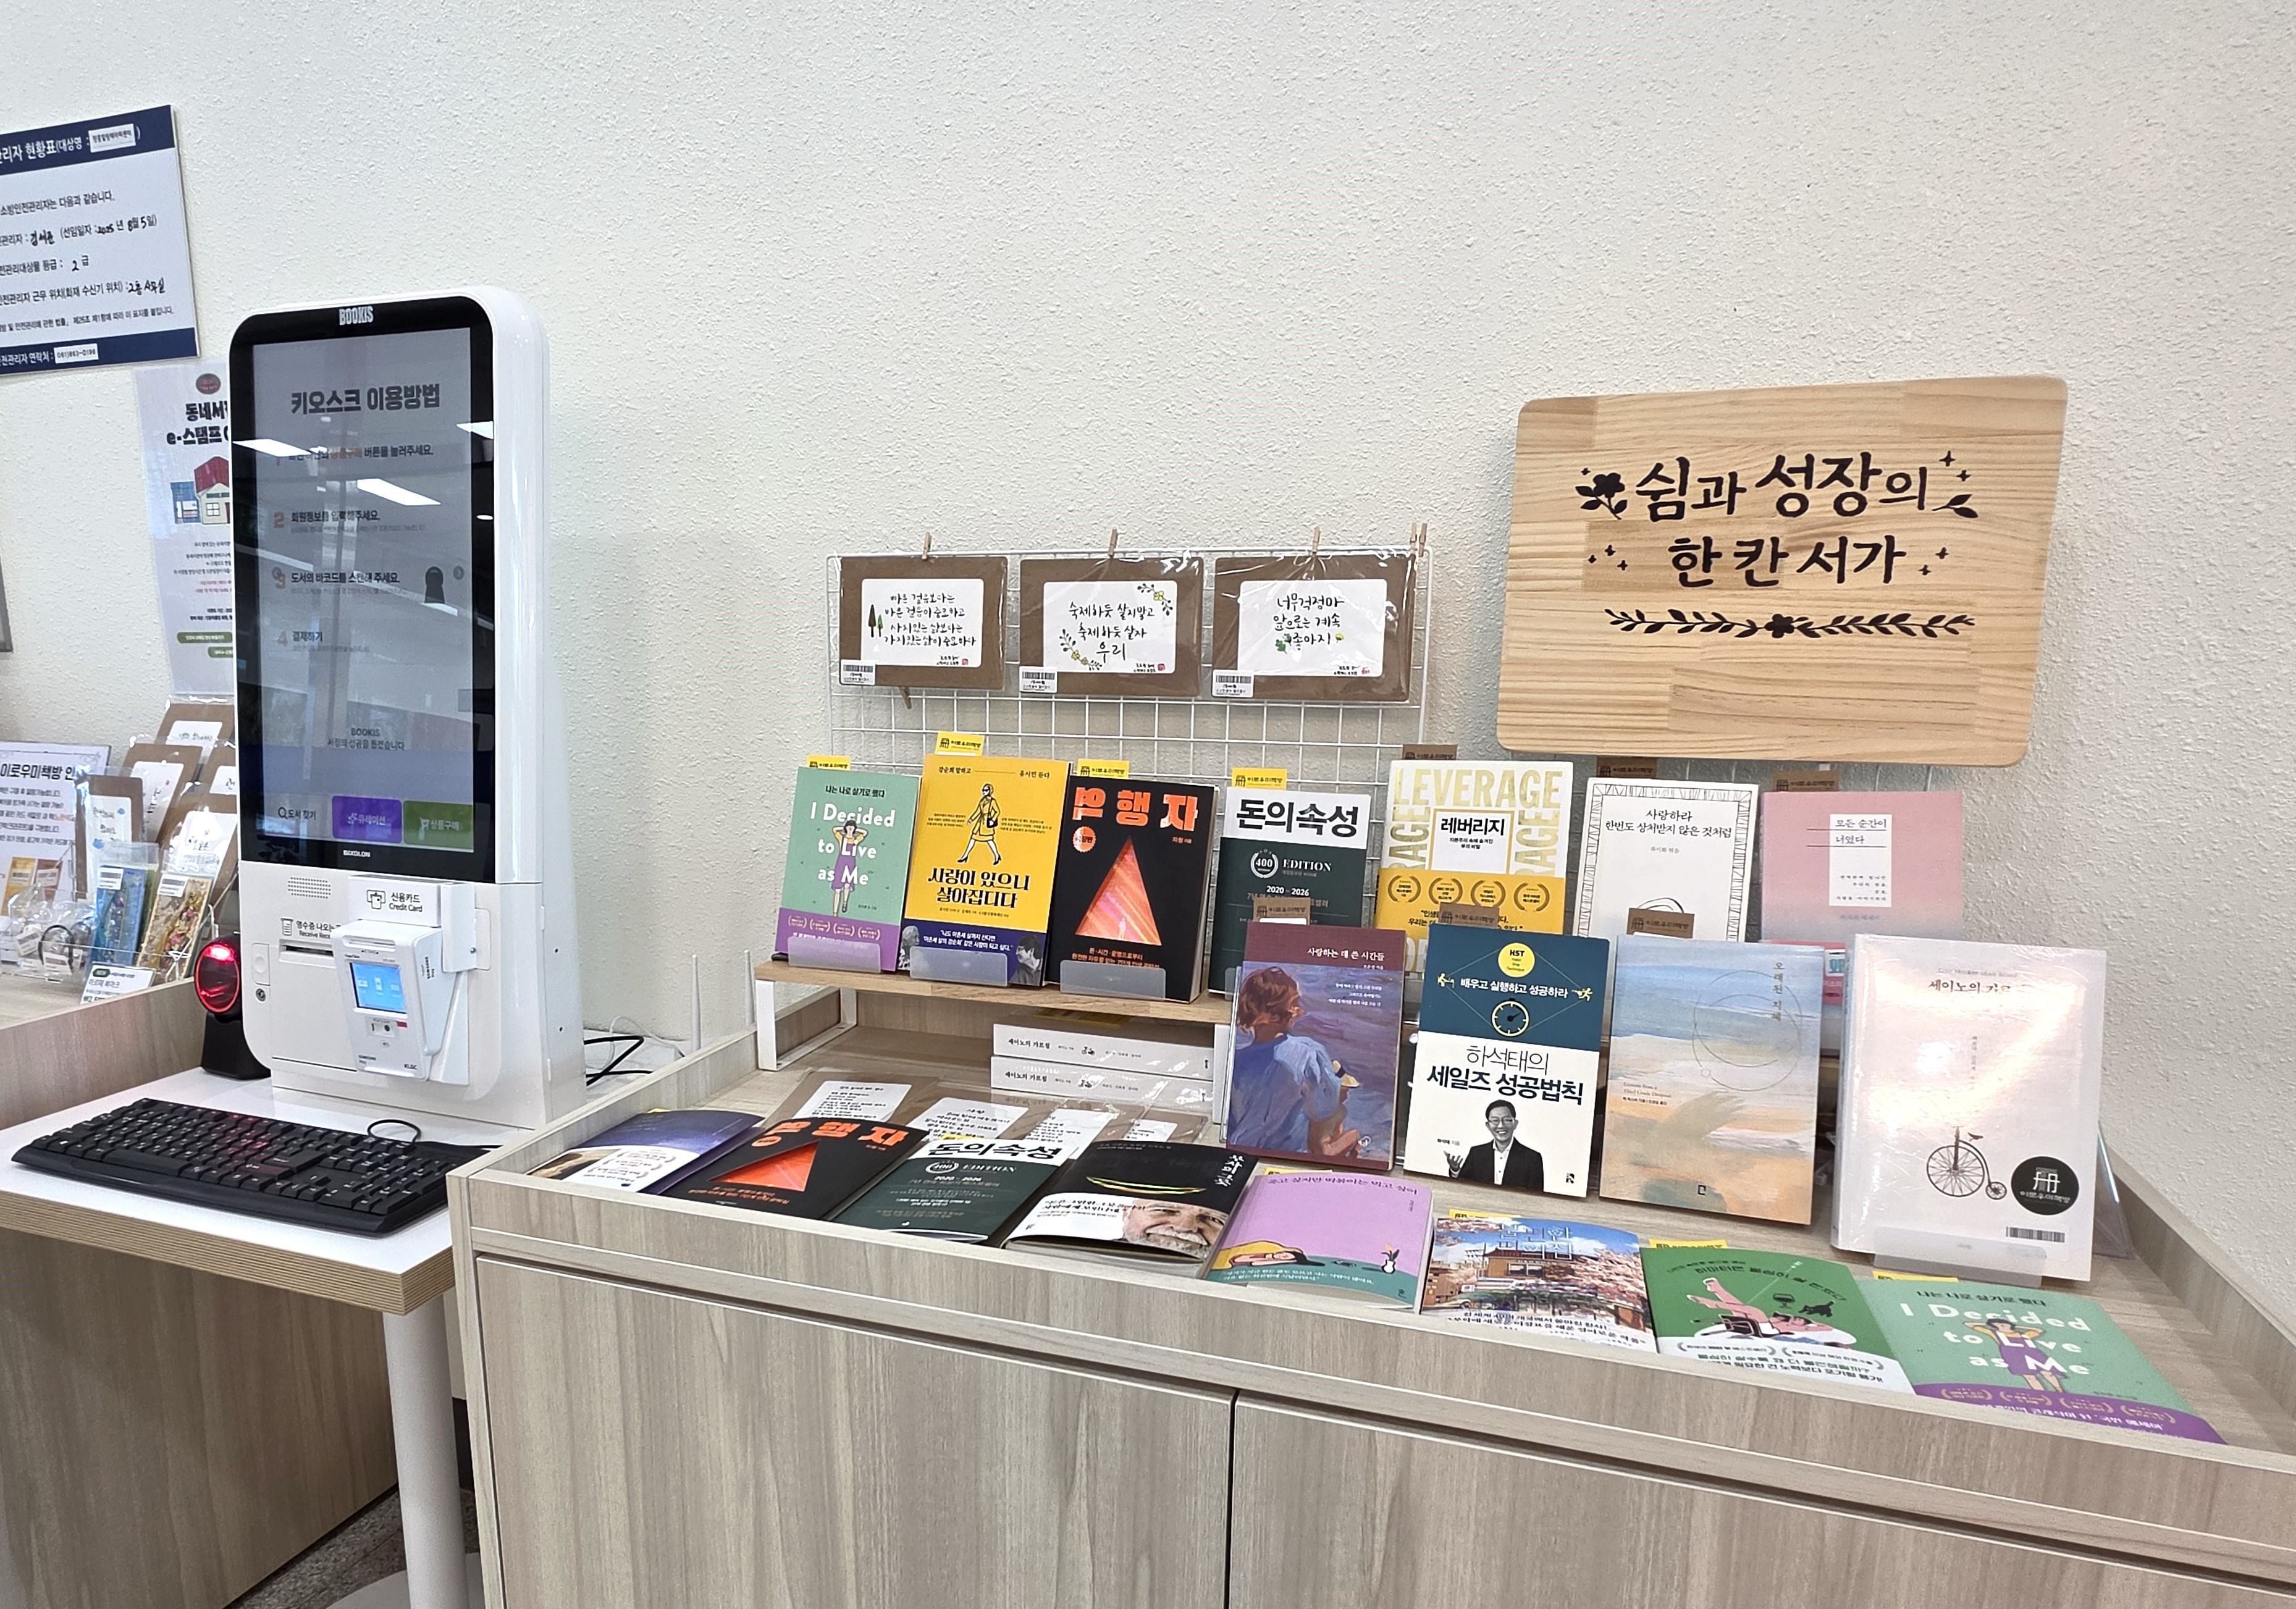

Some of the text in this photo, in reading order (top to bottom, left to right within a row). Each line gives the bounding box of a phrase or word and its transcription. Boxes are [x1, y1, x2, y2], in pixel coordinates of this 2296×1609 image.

[1, 190, 115, 216] 소방안전관리자는 다음과 같습니다.
[117, 219, 124, 232] 년
[72, 260, 79, 271] 2
[82, 255, 89, 266] 급
[33, 290, 46, 302] 근무
[82, 284, 104, 296] 수신기
[339, 306, 374, 326] BOOKIS
[291, 384, 440, 415] 키오스크 이용방법
[364, 445, 389, 458] 버튼을
[1635, 452, 1928, 523] 쉼과 성장의
[274, 510, 329, 528] 2 회원정보를
[1796, 534, 1907, 586] 서가
[291, 572, 314, 584] 도서의
[316, 572, 347, 584] 바코드를
[1069, 601, 1114, 620] 숙제하듯
[1273, 612, 1341, 631] 앞으로는 계속
[277, 631, 323, 647] 4 결제하기
[1077, 622, 1147, 641] 축제하듯 살자
[1096, 641, 1126, 664] 우리
[351, 728, 380, 737] BOOKIS
[1, 763, 63, 780] 이로우미책방
[956, 767, 972, 775] 말하고
[1019, 770, 1050, 779] 유시민 듣다
[825, 784, 838, 794] 나는
[838, 786, 851, 796] 나로
[852, 787, 872, 797] 살기로
[1393, 768, 1564, 809] LEVERAGE
[288, 808, 301, 820] 도서
[358, 813, 386, 826] 큐레이션
[810, 802, 896, 828] I Decided
[1645, 809, 1694, 821] 사랑하라
[431, 817, 460, 831] 상품구매
[1440, 817, 1505, 836] 레버리지
[1605, 820, 1733, 839] 한번도 상처받지 않은 것처럼
[1835, 818, 1888, 829] 모든 순간이
[343, 849, 371, 858] BIXOLON
[818, 838, 877, 859] to Live
[1255, 858, 1332, 872] 400 EDITION
[818, 865, 869, 886] as Me
[927, 867, 1030, 891] 사랑이 있으니
[391, 892, 421, 904] 신용카드
[936, 888, 1018, 909] 살아집디다
[1267, 885, 1310, 897] 2020 2026
[389, 902, 423, 912] Credit Card
[296, 920, 315, 931] 영수증
[1307, 947, 1339, 959] 사랑하는
[1361, 951, 1385, 962] 시간들
[1510, 948, 1526, 958] HST
[1460, 977, 1569, 999] 배우고 실행하고 성공하라
[1928, 979, 1981, 994] 세이노의
[1007, 1038, 1050, 1049] 세이노의 가르침
[1466, 1043, 1550, 1077] 하석태의
[1004, 1070, 1048, 1083] 세이노의 가르침
[1426, 1064, 1584, 1106] 세일즈 성공법칙
[1291, 1176, 1323, 1185] 싶지만
[1324, 1177, 1370, 1186] 떡볶이는
[1371, 1180, 1394, 1190] 먹고
[1395, 1183, 1419, 1196] 싶어
[2019, 1190, 2071, 1204] 이로우미책방
[1899, 1303, 2092, 1332] I Decided
[1943, 1330, 2084, 1354] to Live
[1969, 1354, 2091, 1376] as Me
